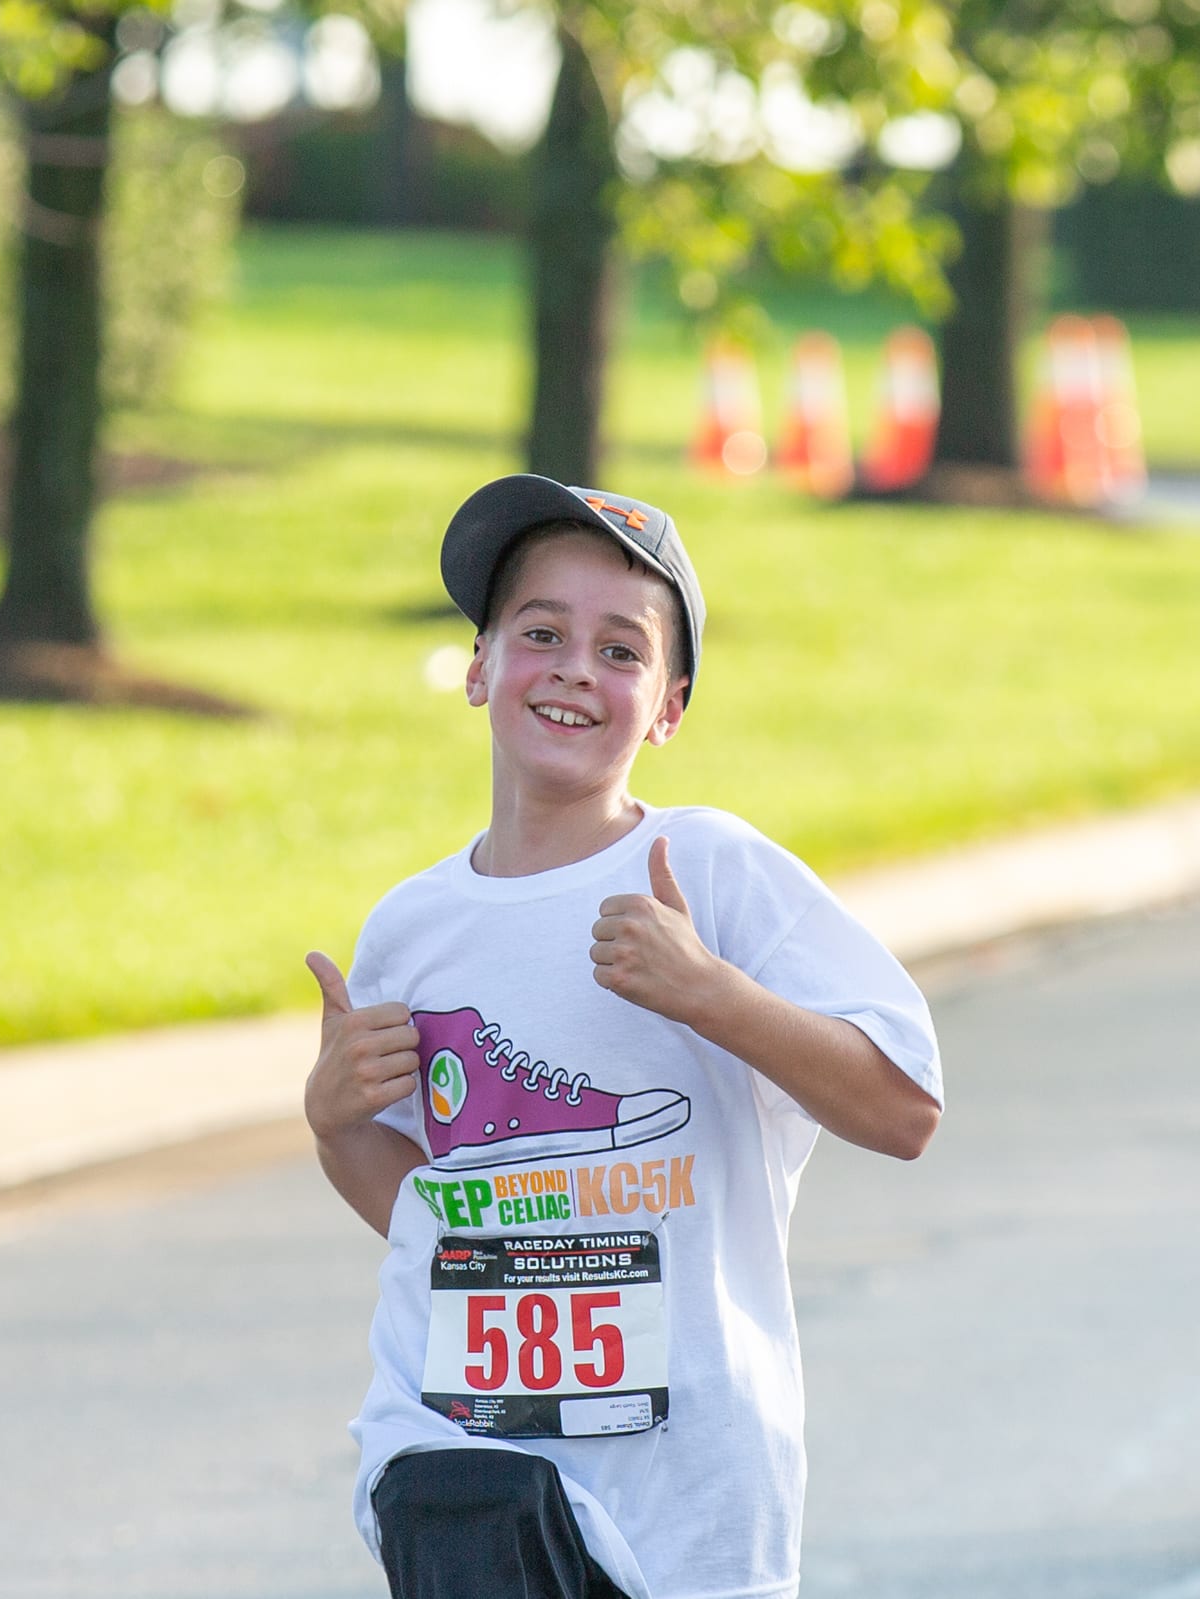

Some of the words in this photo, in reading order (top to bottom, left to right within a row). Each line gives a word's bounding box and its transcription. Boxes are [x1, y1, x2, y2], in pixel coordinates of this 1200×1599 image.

[493, 1169, 567, 1199] BEYOND
[576, 1154, 696, 1217] KC5K
[497, 1193, 571, 1226] CELIAC
[503, 1238, 575, 1251] RACEDAY
[579, 1234, 642, 1249] TIMING
[440, 1260, 468, 1270] Kansas
[468, 1260, 487, 1272] City
[513, 1253, 633, 1270] SOLUTIONS
[503, 1273, 516, 1283] For
[516, 1274, 535, 1286] your
[535, 1272, 561, 1283] results
[561, 1271, 580, 1283] visit
[581, 1269, 649, 1281] ResultsKC.com
[464, 1291, 625, 1391] 585
